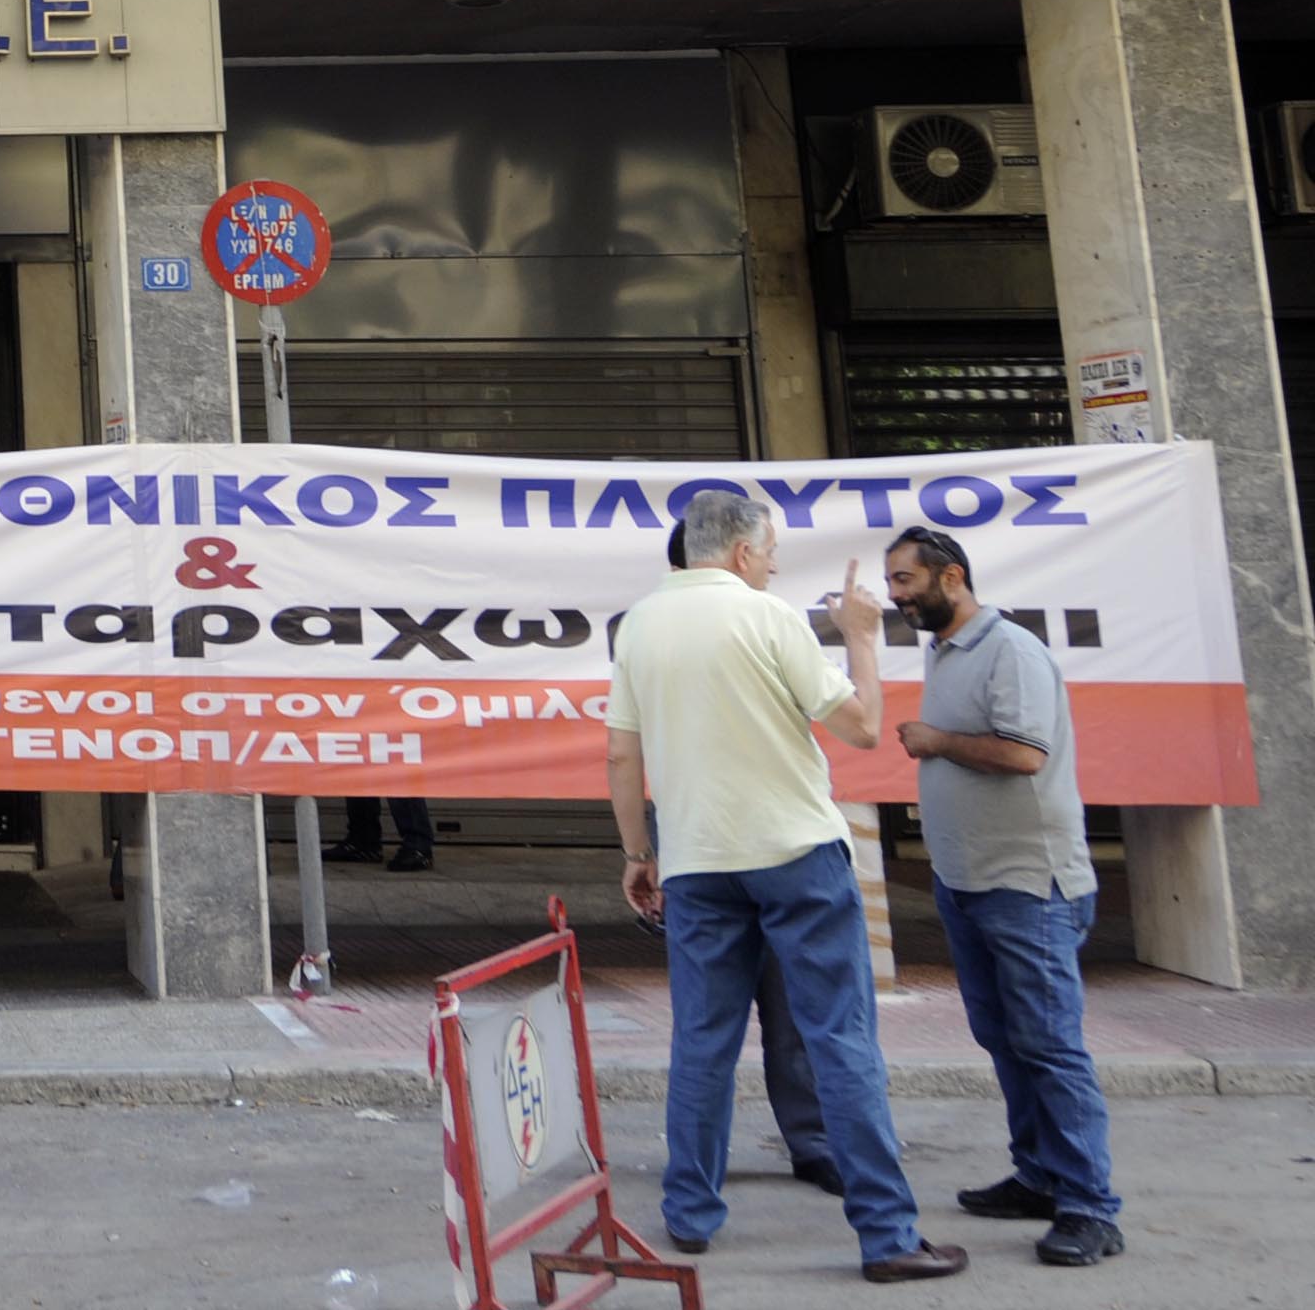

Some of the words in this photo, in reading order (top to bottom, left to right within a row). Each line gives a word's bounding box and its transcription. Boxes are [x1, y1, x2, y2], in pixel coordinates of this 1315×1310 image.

[261, 221, 297, 237] 5075
[264, 238, 293, 254] 746
[153, 262, 180, 286] 30
[174, 536, 263, 590] &
[180, 692, 363, 719] στον
[507, 1055, 546, 1133] ΔΕΗ
